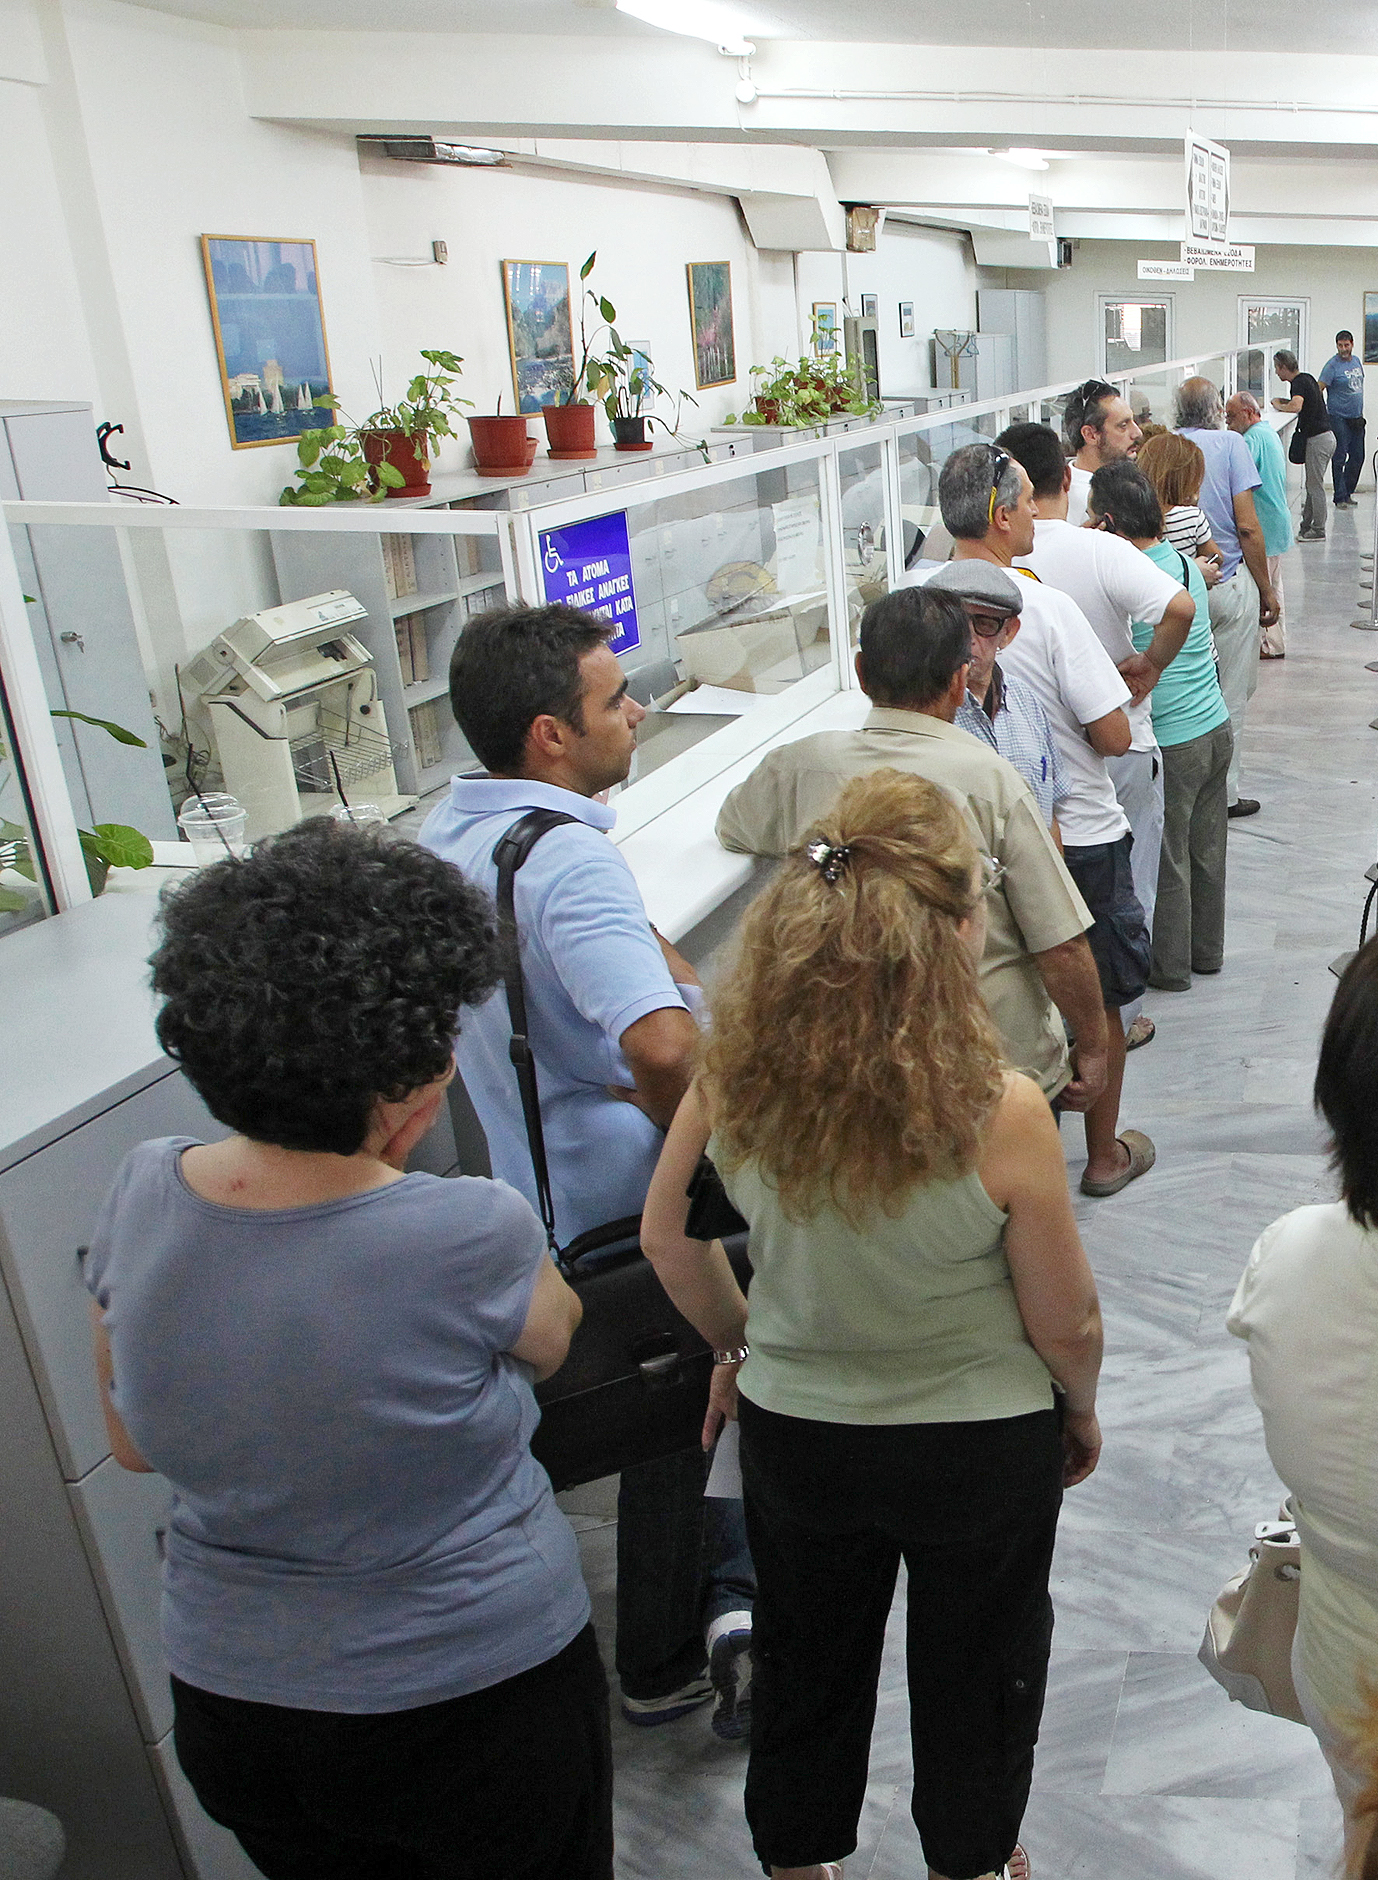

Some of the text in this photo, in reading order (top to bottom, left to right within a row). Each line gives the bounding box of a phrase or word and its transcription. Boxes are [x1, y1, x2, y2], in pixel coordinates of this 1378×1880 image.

[566, 559, 610, 587] ΤΑ ΑΤΟΜΑ
[598, 574, 630, 600] ΑΝΑΓΚΕΣ
[615, 595, 634, 616] ΚΑΤΑ
